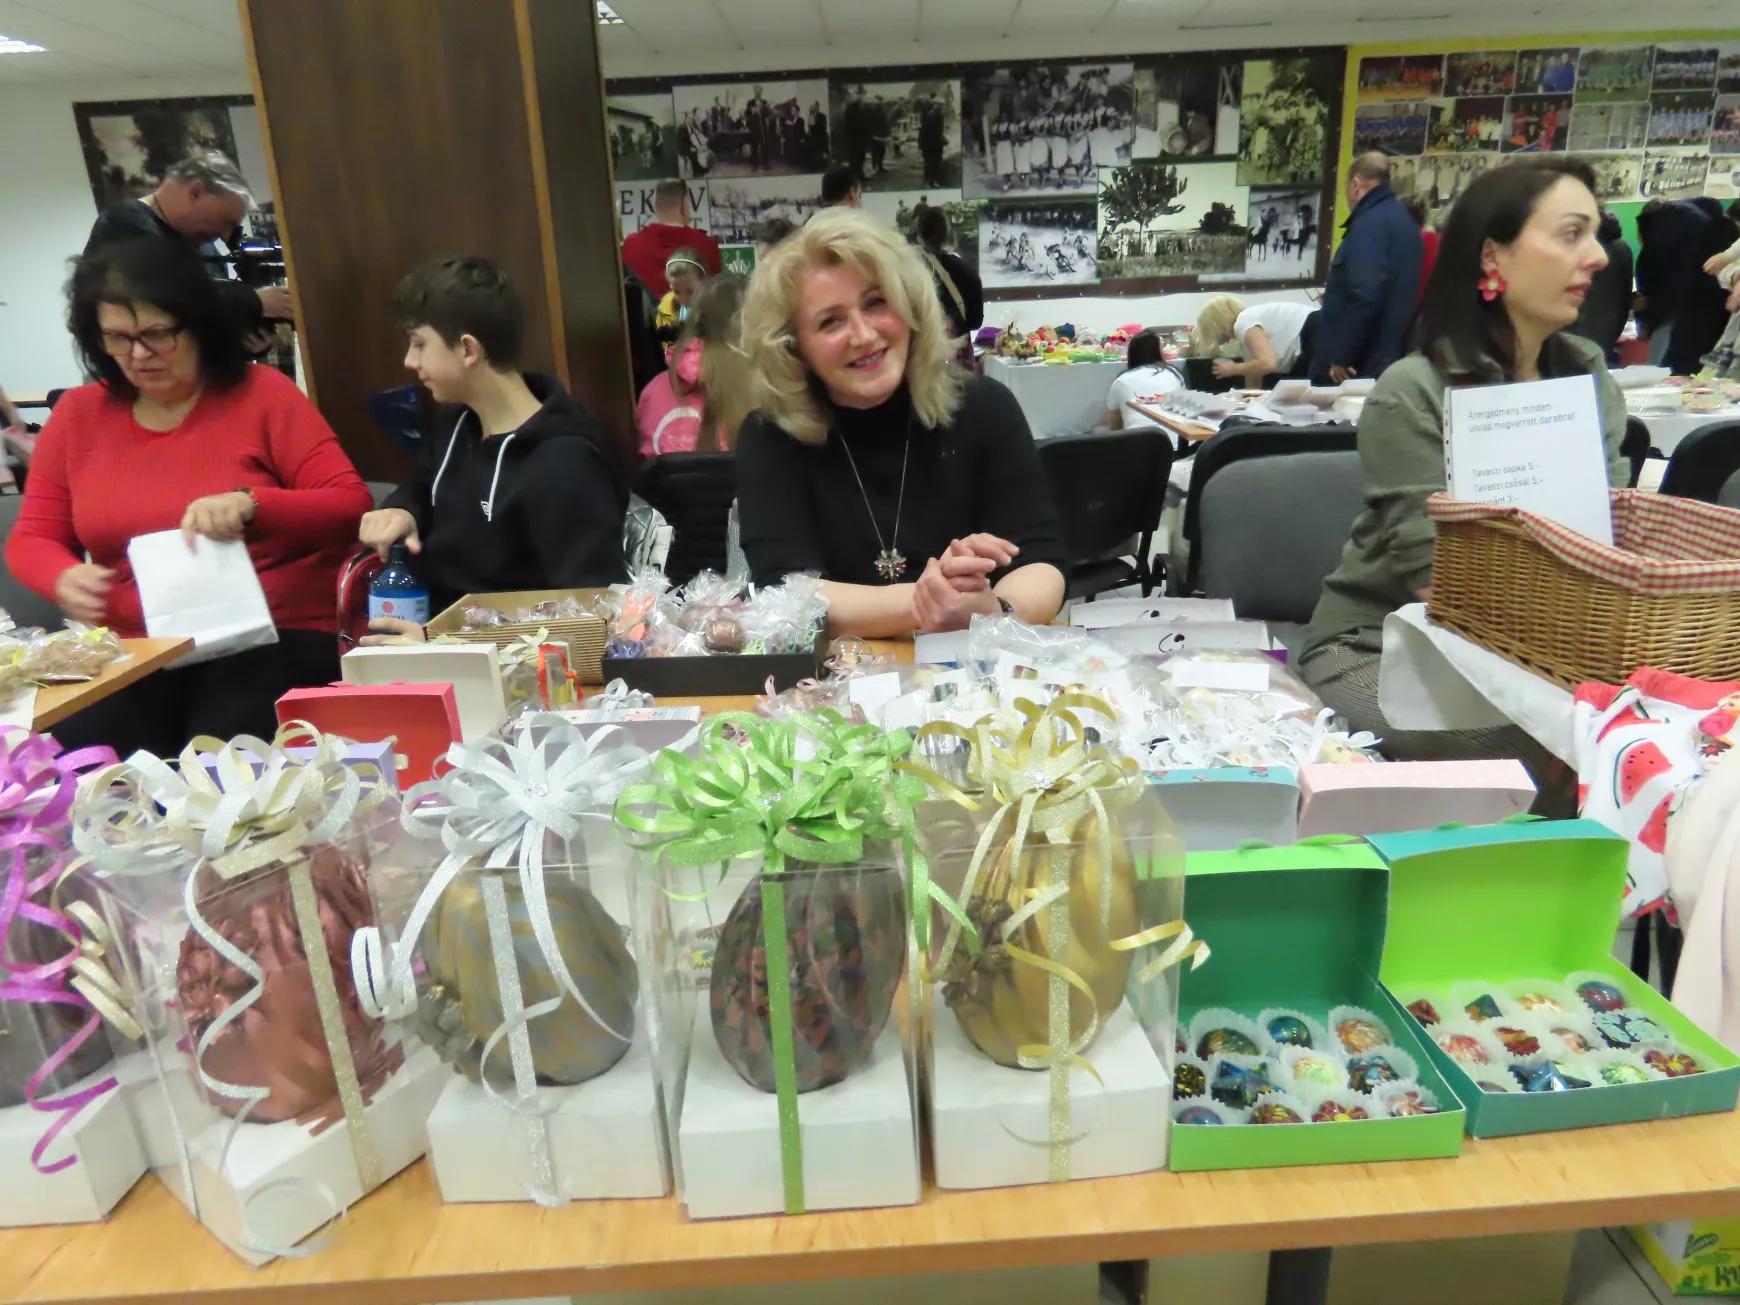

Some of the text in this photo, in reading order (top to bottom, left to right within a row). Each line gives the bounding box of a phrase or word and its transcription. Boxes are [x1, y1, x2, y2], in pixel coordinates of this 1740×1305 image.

[1522, 403, 1551, 414] minden
[1472, 467, 1501, 477] Tavaszi
[1503, 464, 1526, 475] sapka
[1474, 482, 1503, 492] Tavaszi
